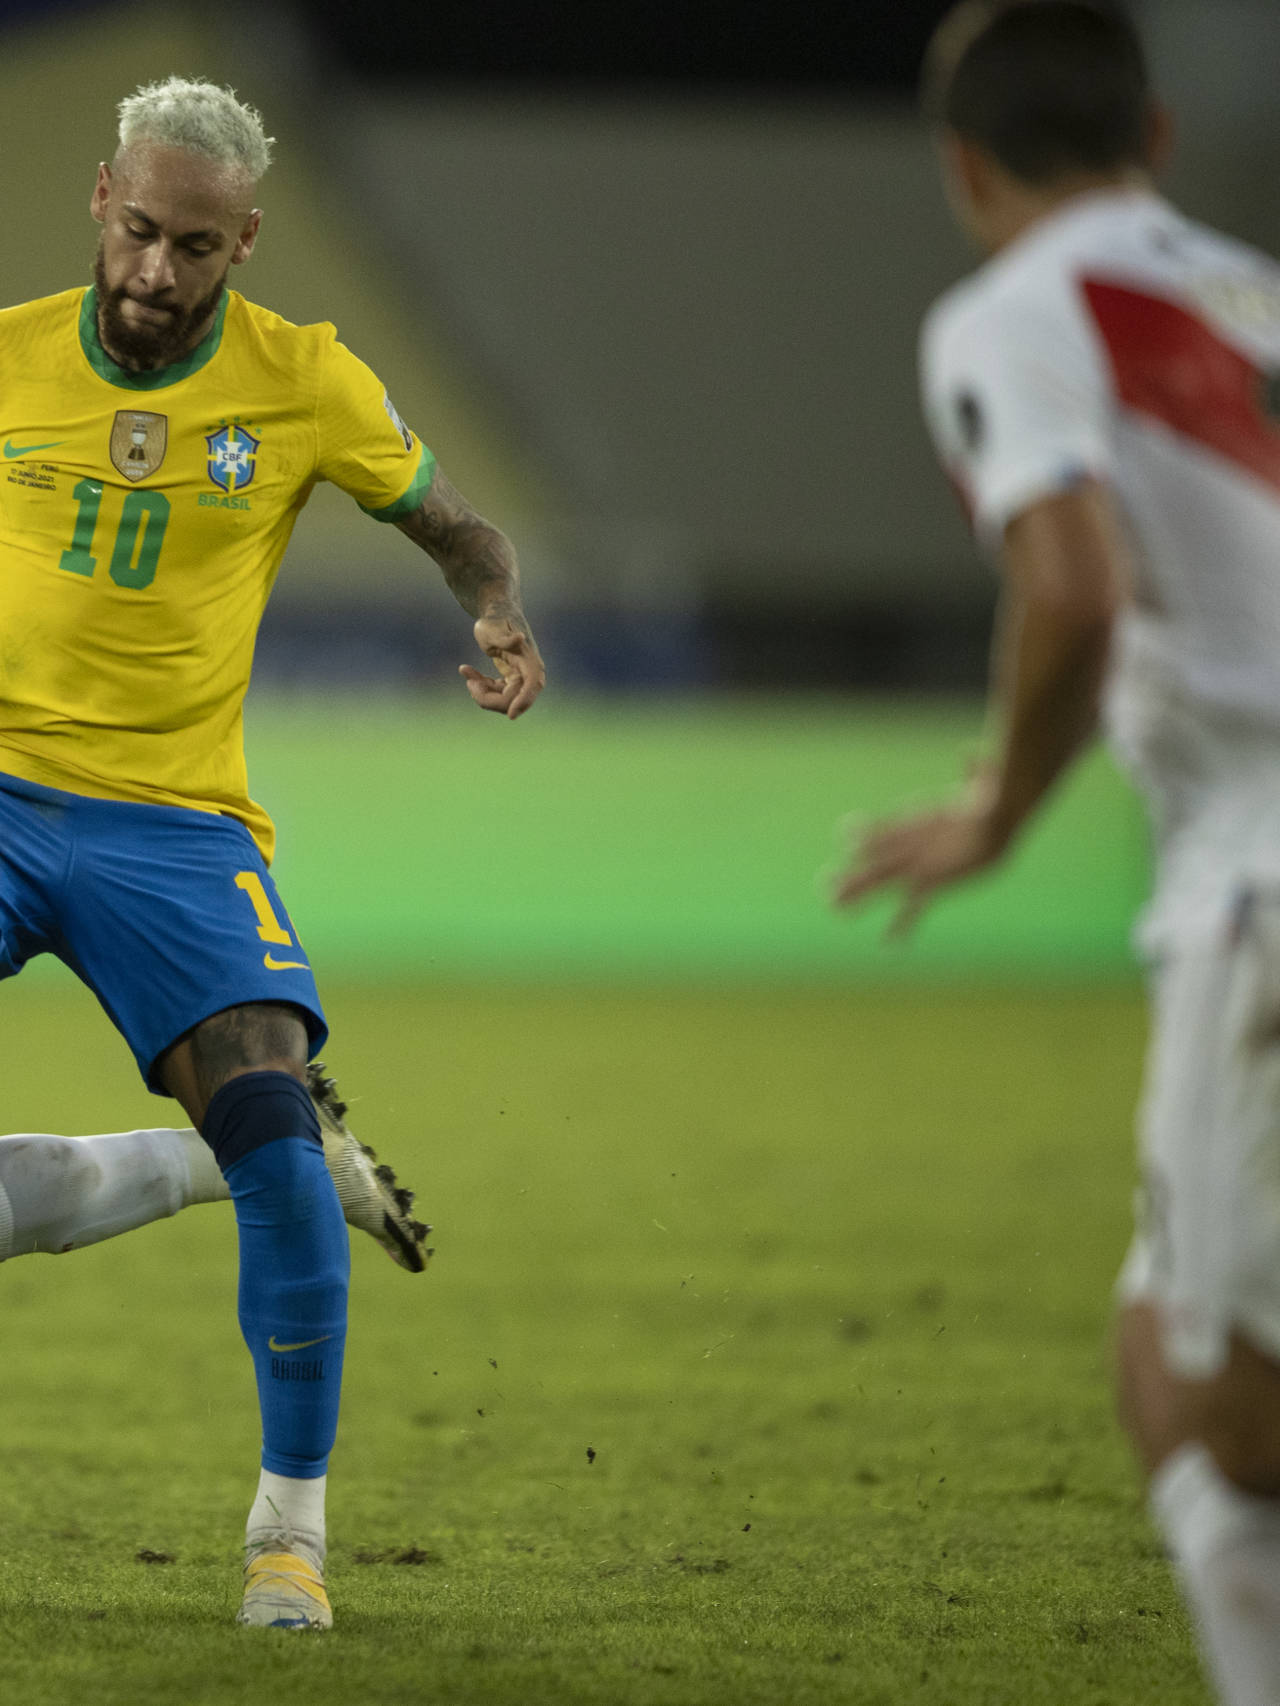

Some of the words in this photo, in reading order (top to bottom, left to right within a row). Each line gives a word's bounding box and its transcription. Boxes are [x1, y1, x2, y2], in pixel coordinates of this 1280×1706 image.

[222, 452, 243, 462] CBF
[198, 493, 251, 511] BRASIL
[58, 476, 171, 591] 10
[233, 871, 302, 947] 1
